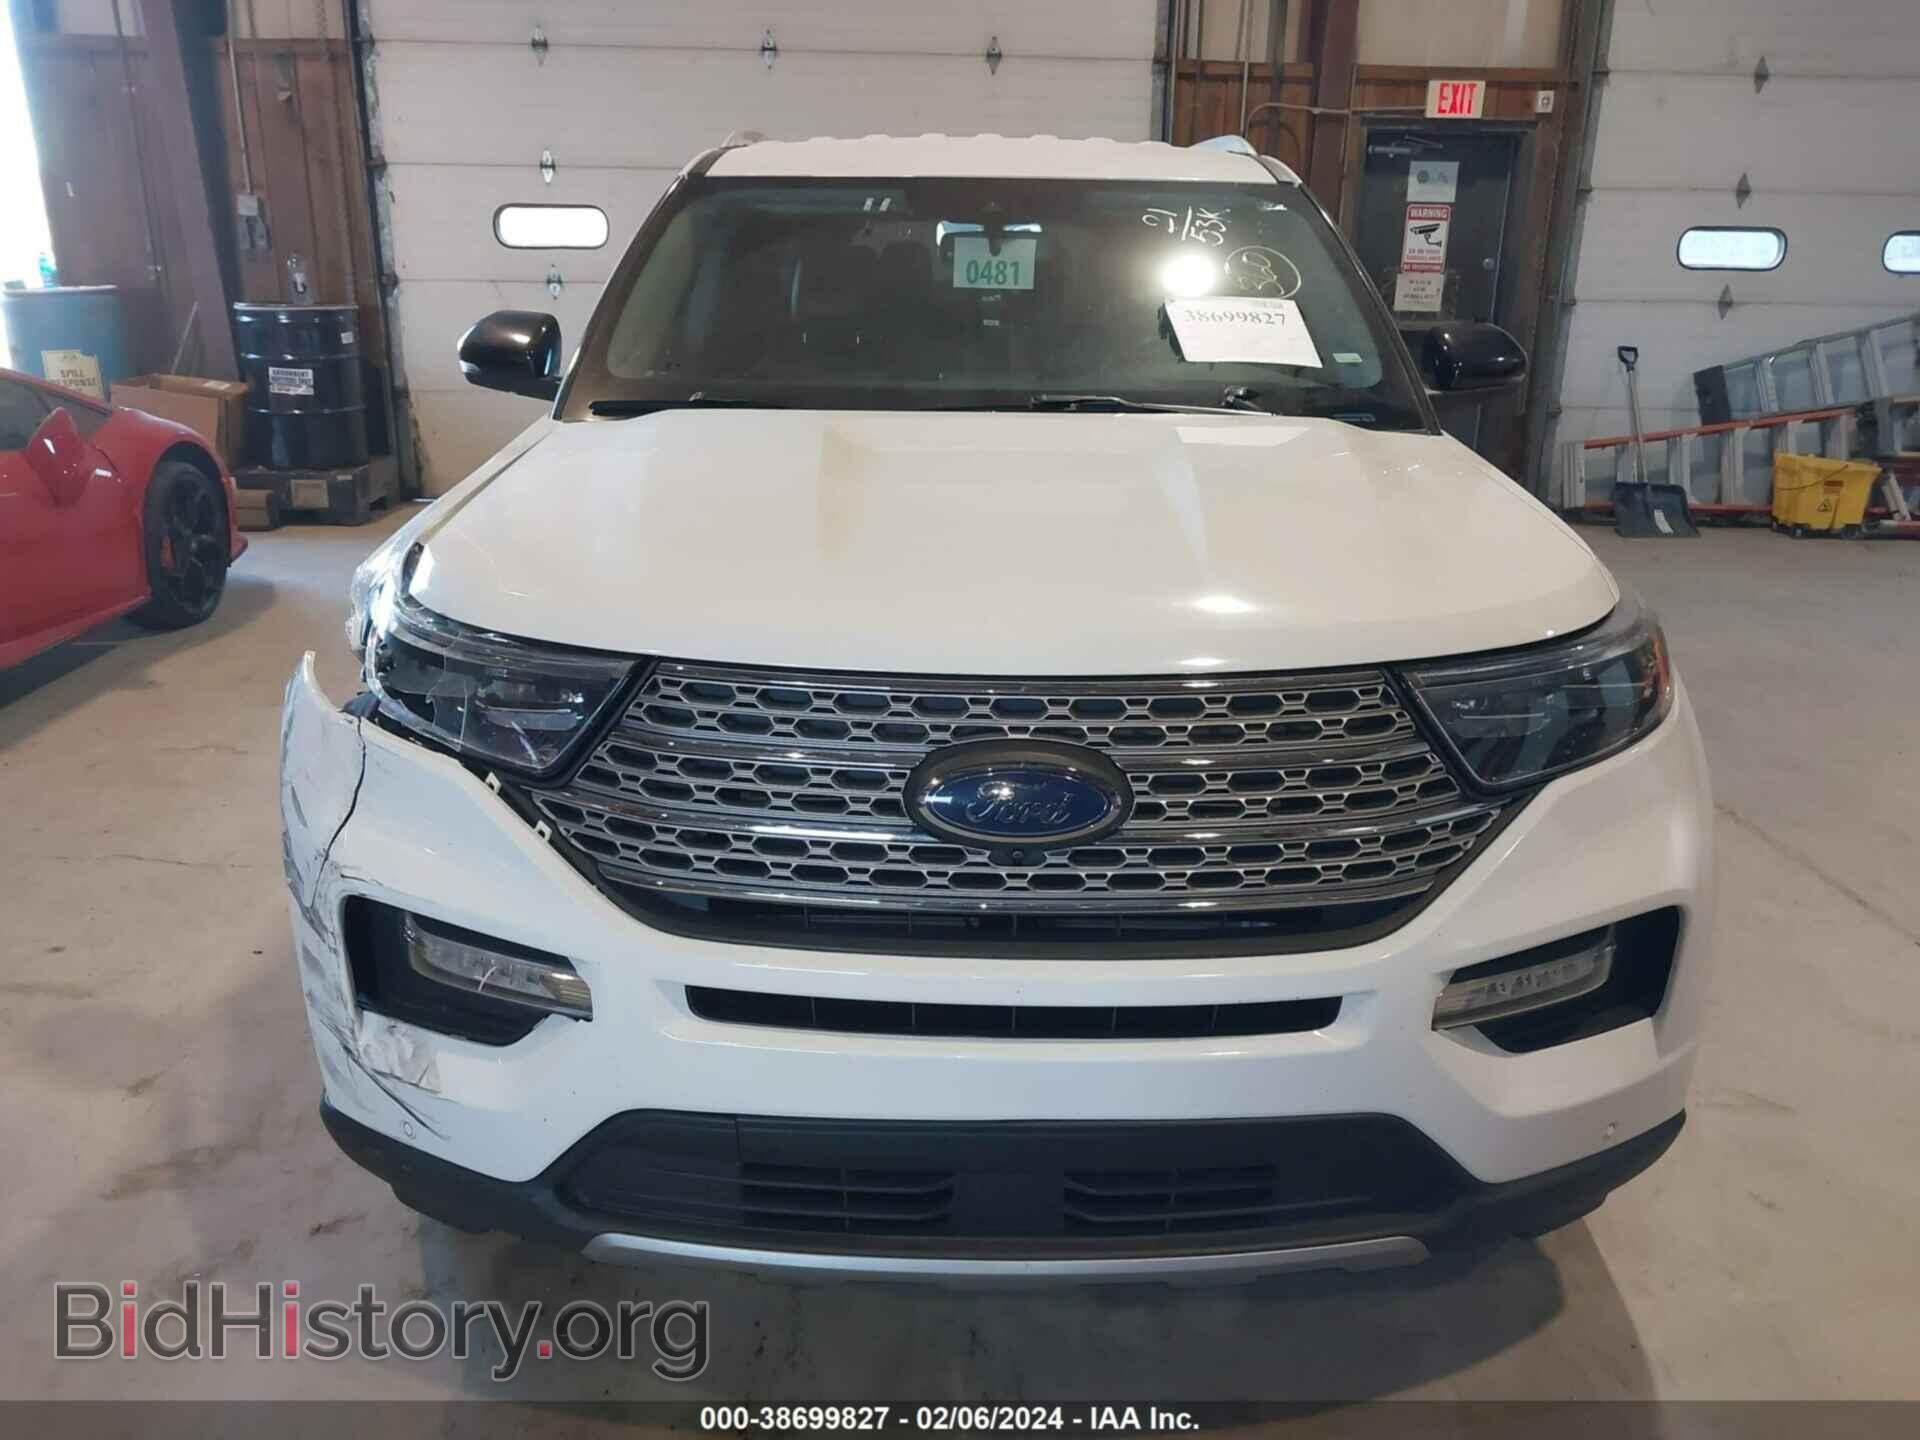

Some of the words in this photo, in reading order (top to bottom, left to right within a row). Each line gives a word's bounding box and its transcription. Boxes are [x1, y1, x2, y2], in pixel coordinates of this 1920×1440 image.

[1438, 83, 1477, 114] EXIT
[1410, 208, 1448, 218] WARNING
[966, 260, 1020, 286] 0481
[1184, 308, 1286, 328] 38699827
[965, 780, 1076, 824] Ford
